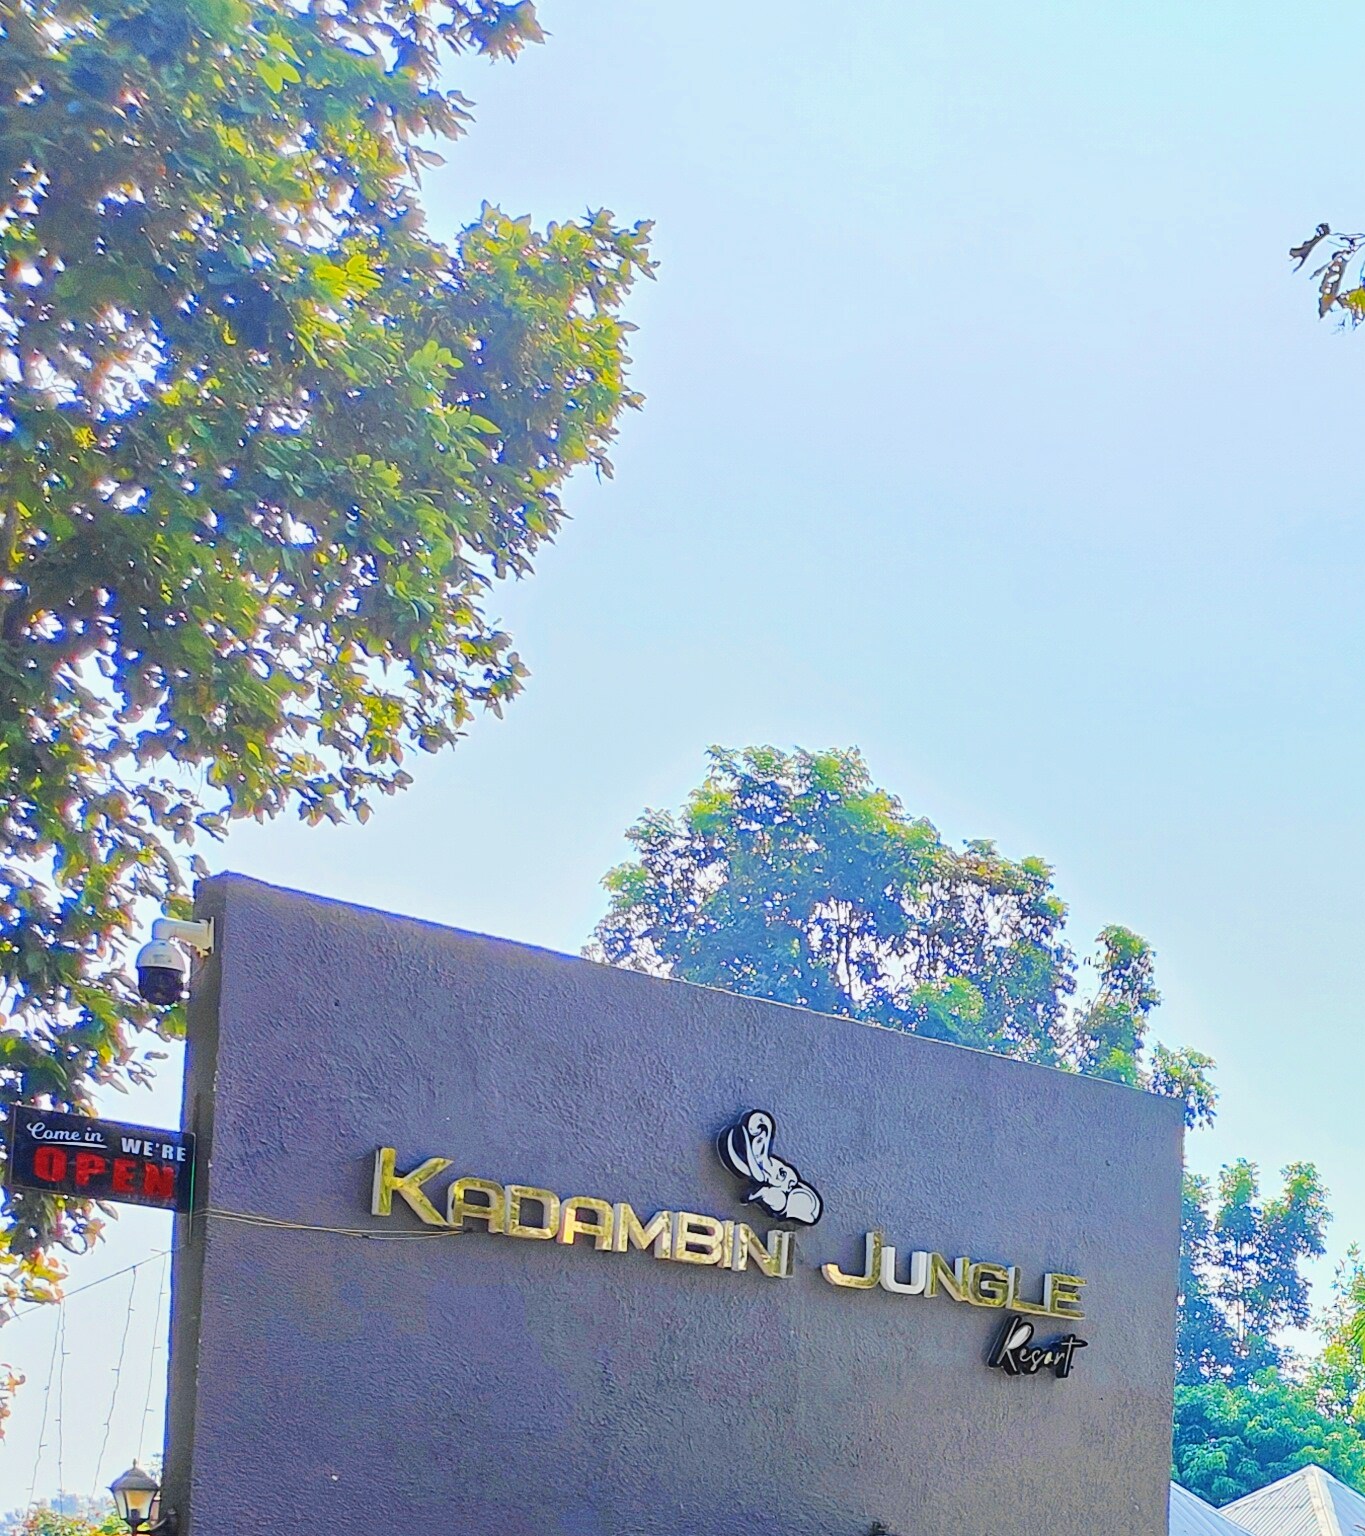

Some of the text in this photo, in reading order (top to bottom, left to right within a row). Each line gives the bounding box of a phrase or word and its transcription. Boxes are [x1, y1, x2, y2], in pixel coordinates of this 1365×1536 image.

[26, 1122, 187, 1162] Come in WE'RE
[33, 1146, 176, 1198] OPEN
[371, 1147, 1088, 1320] KADAMBINI JUNGLE
[994, 1318, 1088, 1377] Resort
